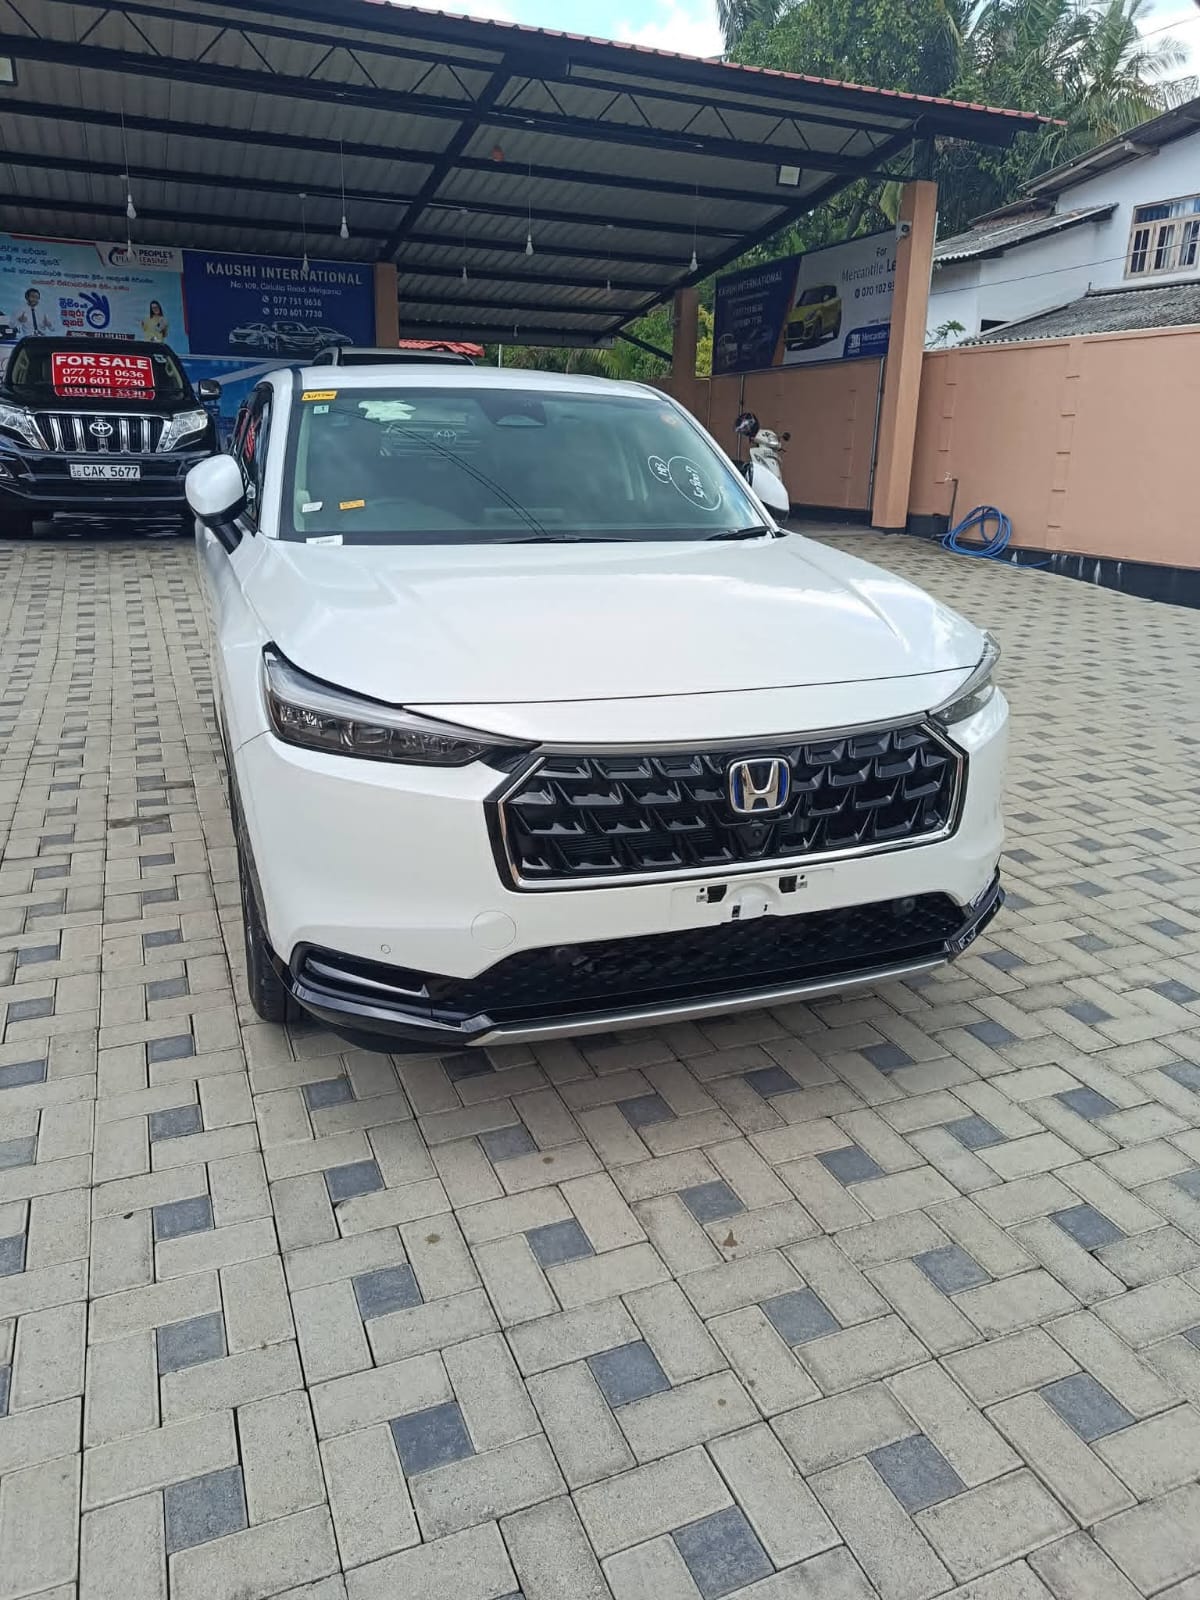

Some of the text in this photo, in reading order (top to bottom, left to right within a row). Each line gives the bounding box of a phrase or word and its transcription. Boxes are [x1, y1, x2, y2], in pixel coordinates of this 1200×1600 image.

[876, 247, 887, 257] For
[139, 256, 168, 265] LEASING
[206, 262, 363, 285] KAUSHI INTERNATIONAL
[842, 263, 884, 281] Mercantile
[861, 285, 873, 297] 070
[273, 296, 287, 304] 077
[289, 297, 301, 306] 751
[274, 308, 322, 318] 070 601 7730
[55, 356, 149, 370] FOR SALE
[89, 368, 110, 376] 751
[114, 369, 145, 378] 0636
[63, 376, 145, 387] 070 601 7730
[83, 465, 105, 477] CAK
[110, 466, 138, 478] 5677
